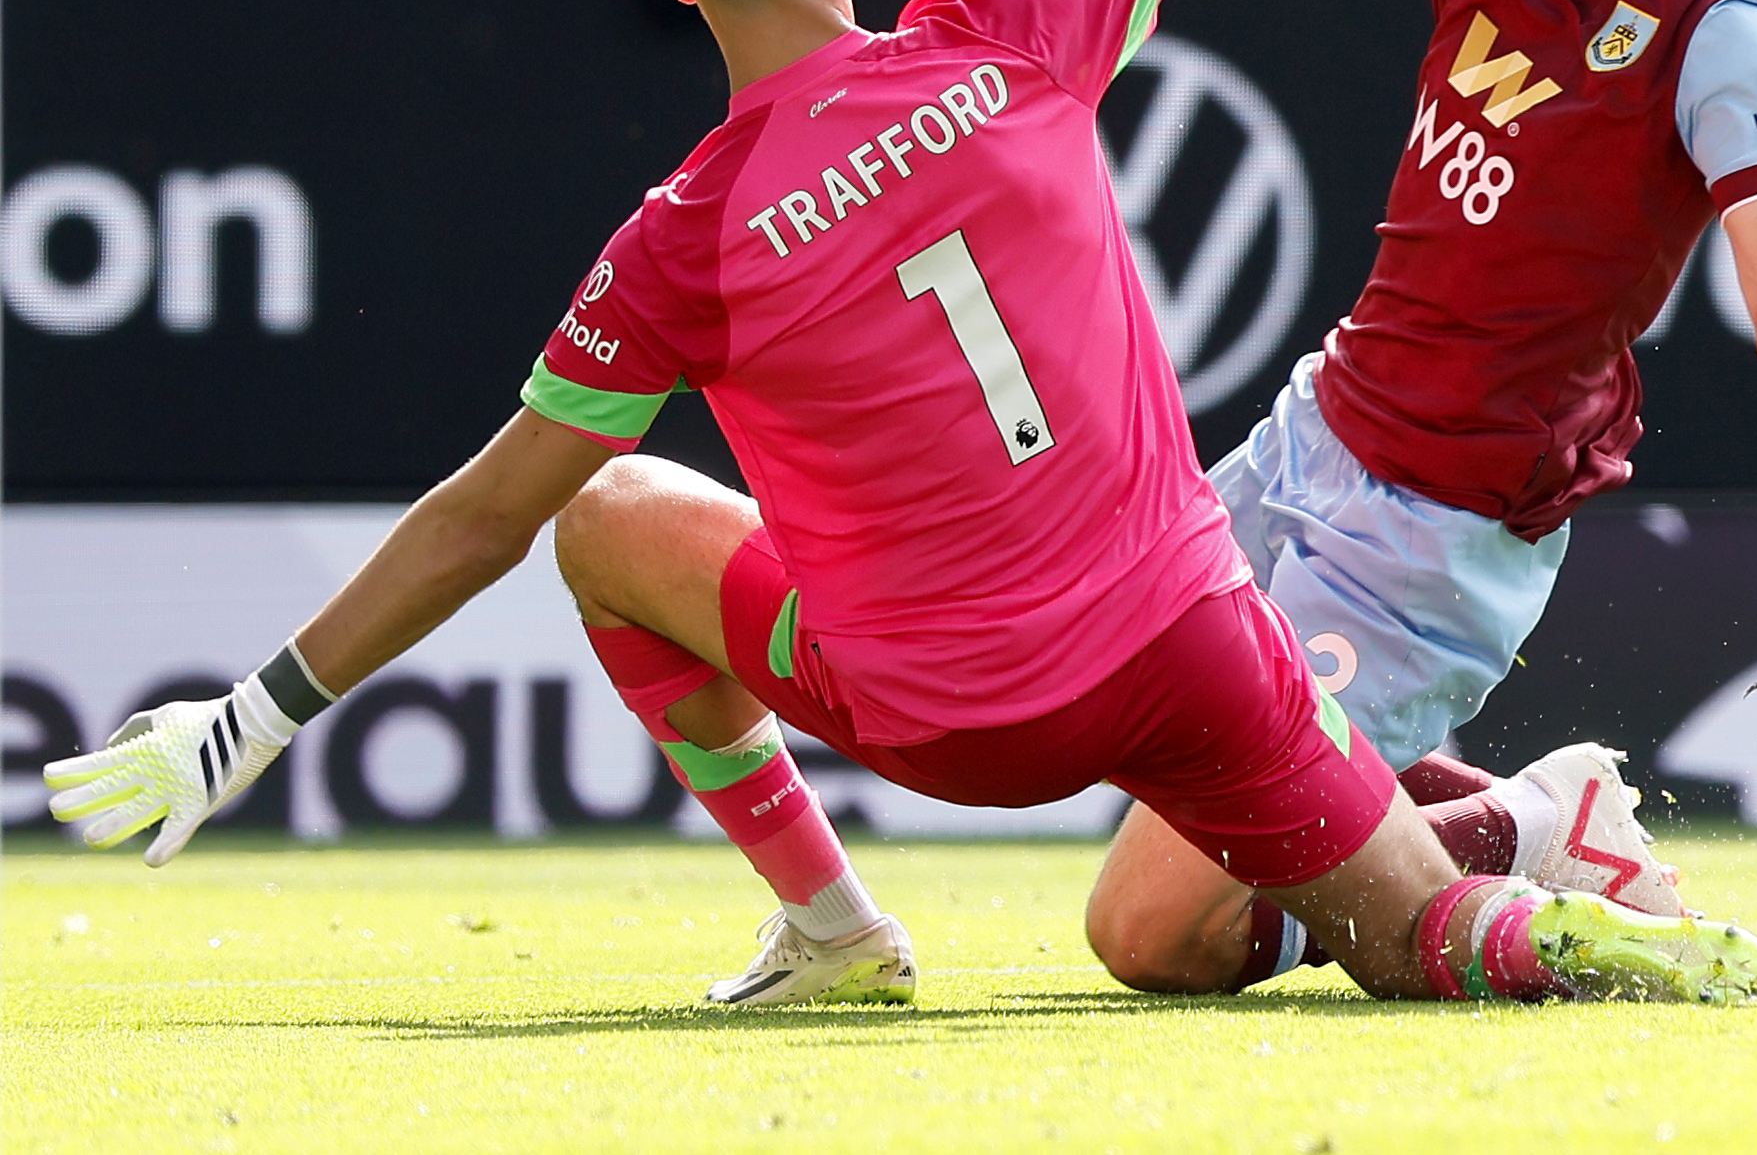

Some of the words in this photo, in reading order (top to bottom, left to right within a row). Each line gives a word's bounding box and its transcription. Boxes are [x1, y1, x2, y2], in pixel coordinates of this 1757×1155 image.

[746, 63, 1010, 259] TRAFFORD
[809, 87, 848, 119] Clarets
[1407, 82, 1515, 225] W88
[895, 228, 1057, 468] 1
